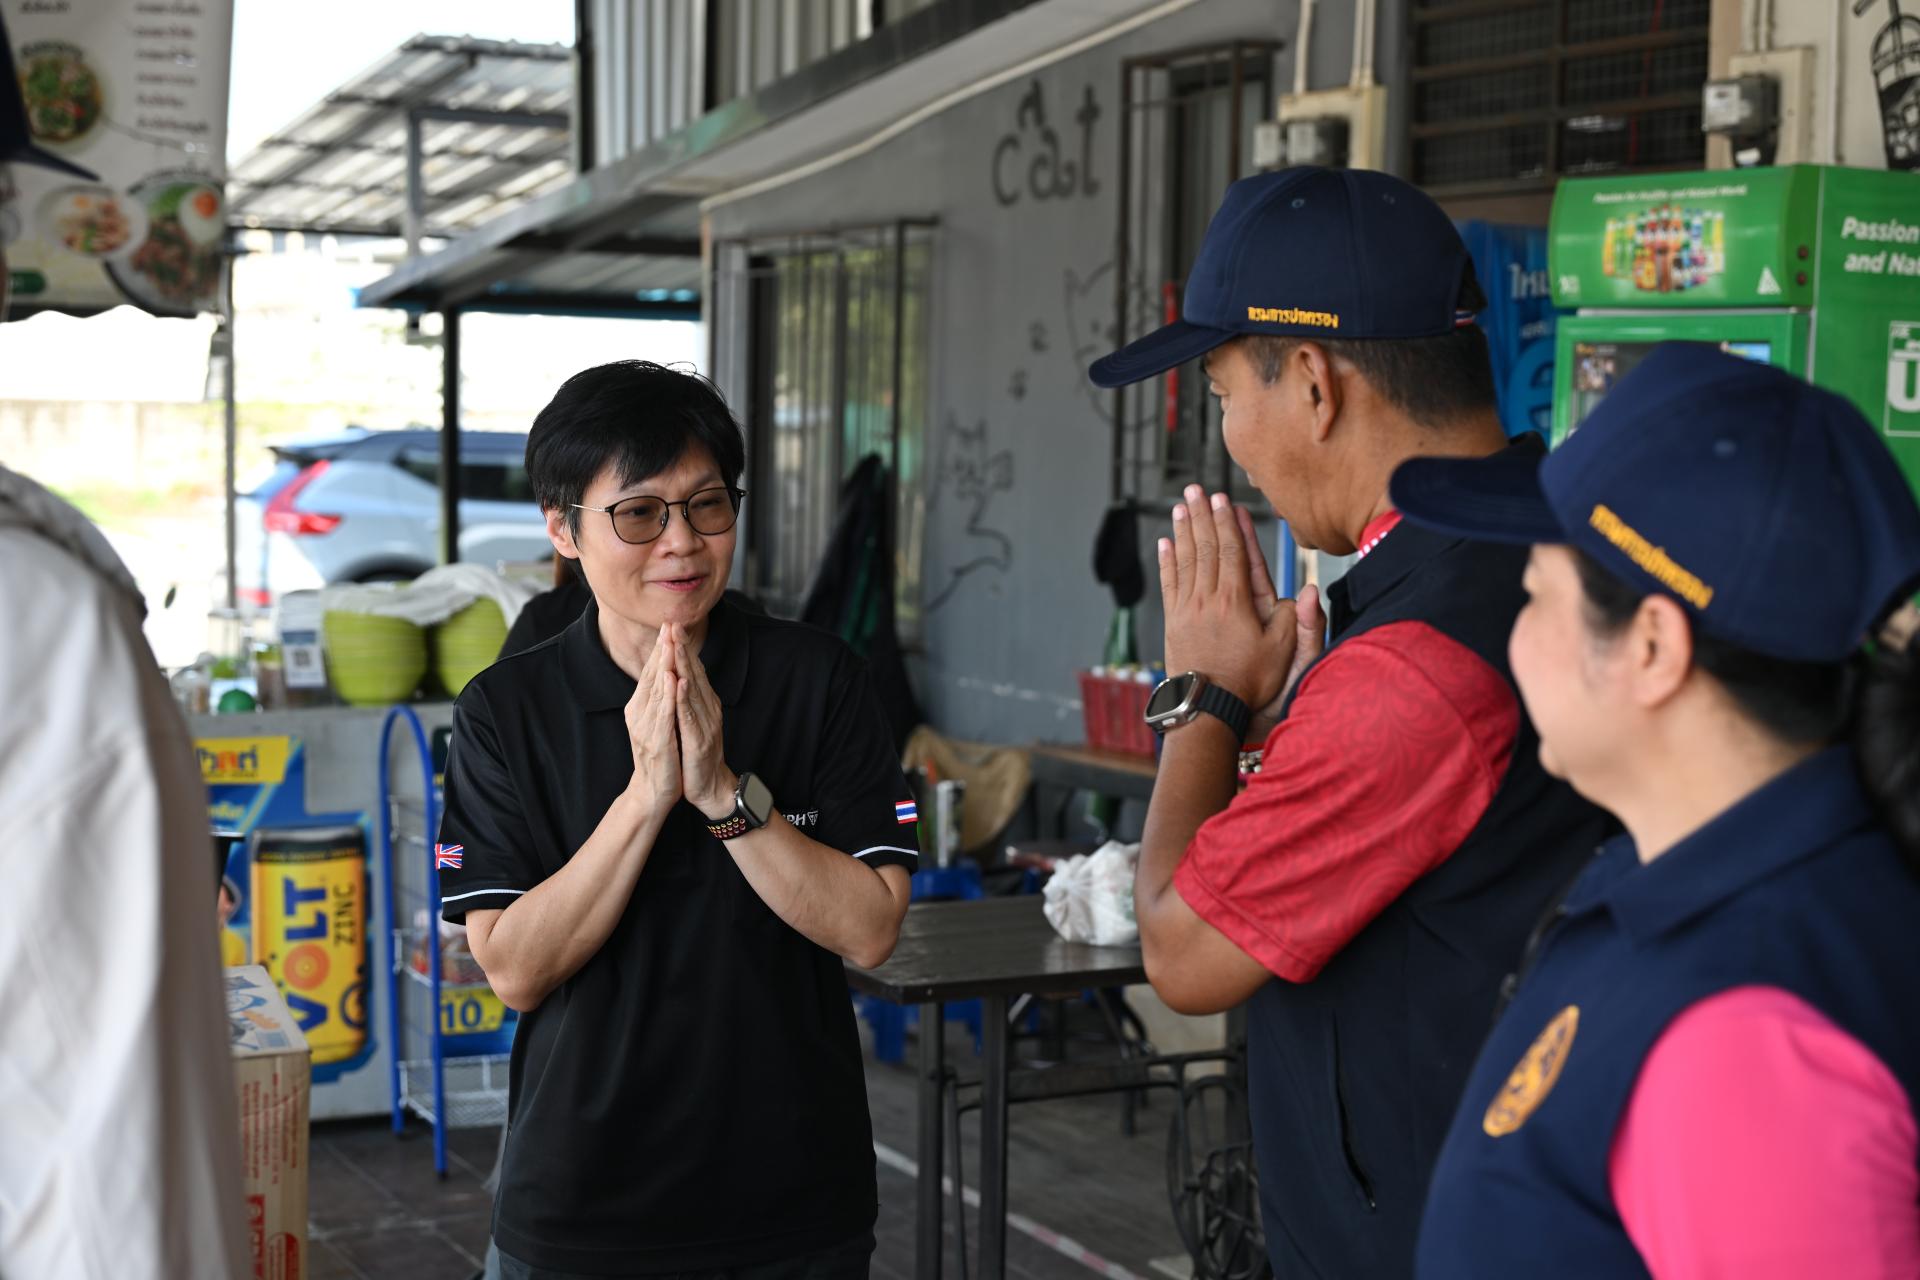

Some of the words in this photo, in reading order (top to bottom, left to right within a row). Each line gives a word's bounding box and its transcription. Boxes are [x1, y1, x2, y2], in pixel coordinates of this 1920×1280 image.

[1841, 216, 1919, 243] Passion
[1844, 251, 1887, 274] and
[333, 884, 357, 947] ZINC
[284, 875, 331, 1034] VOLT
